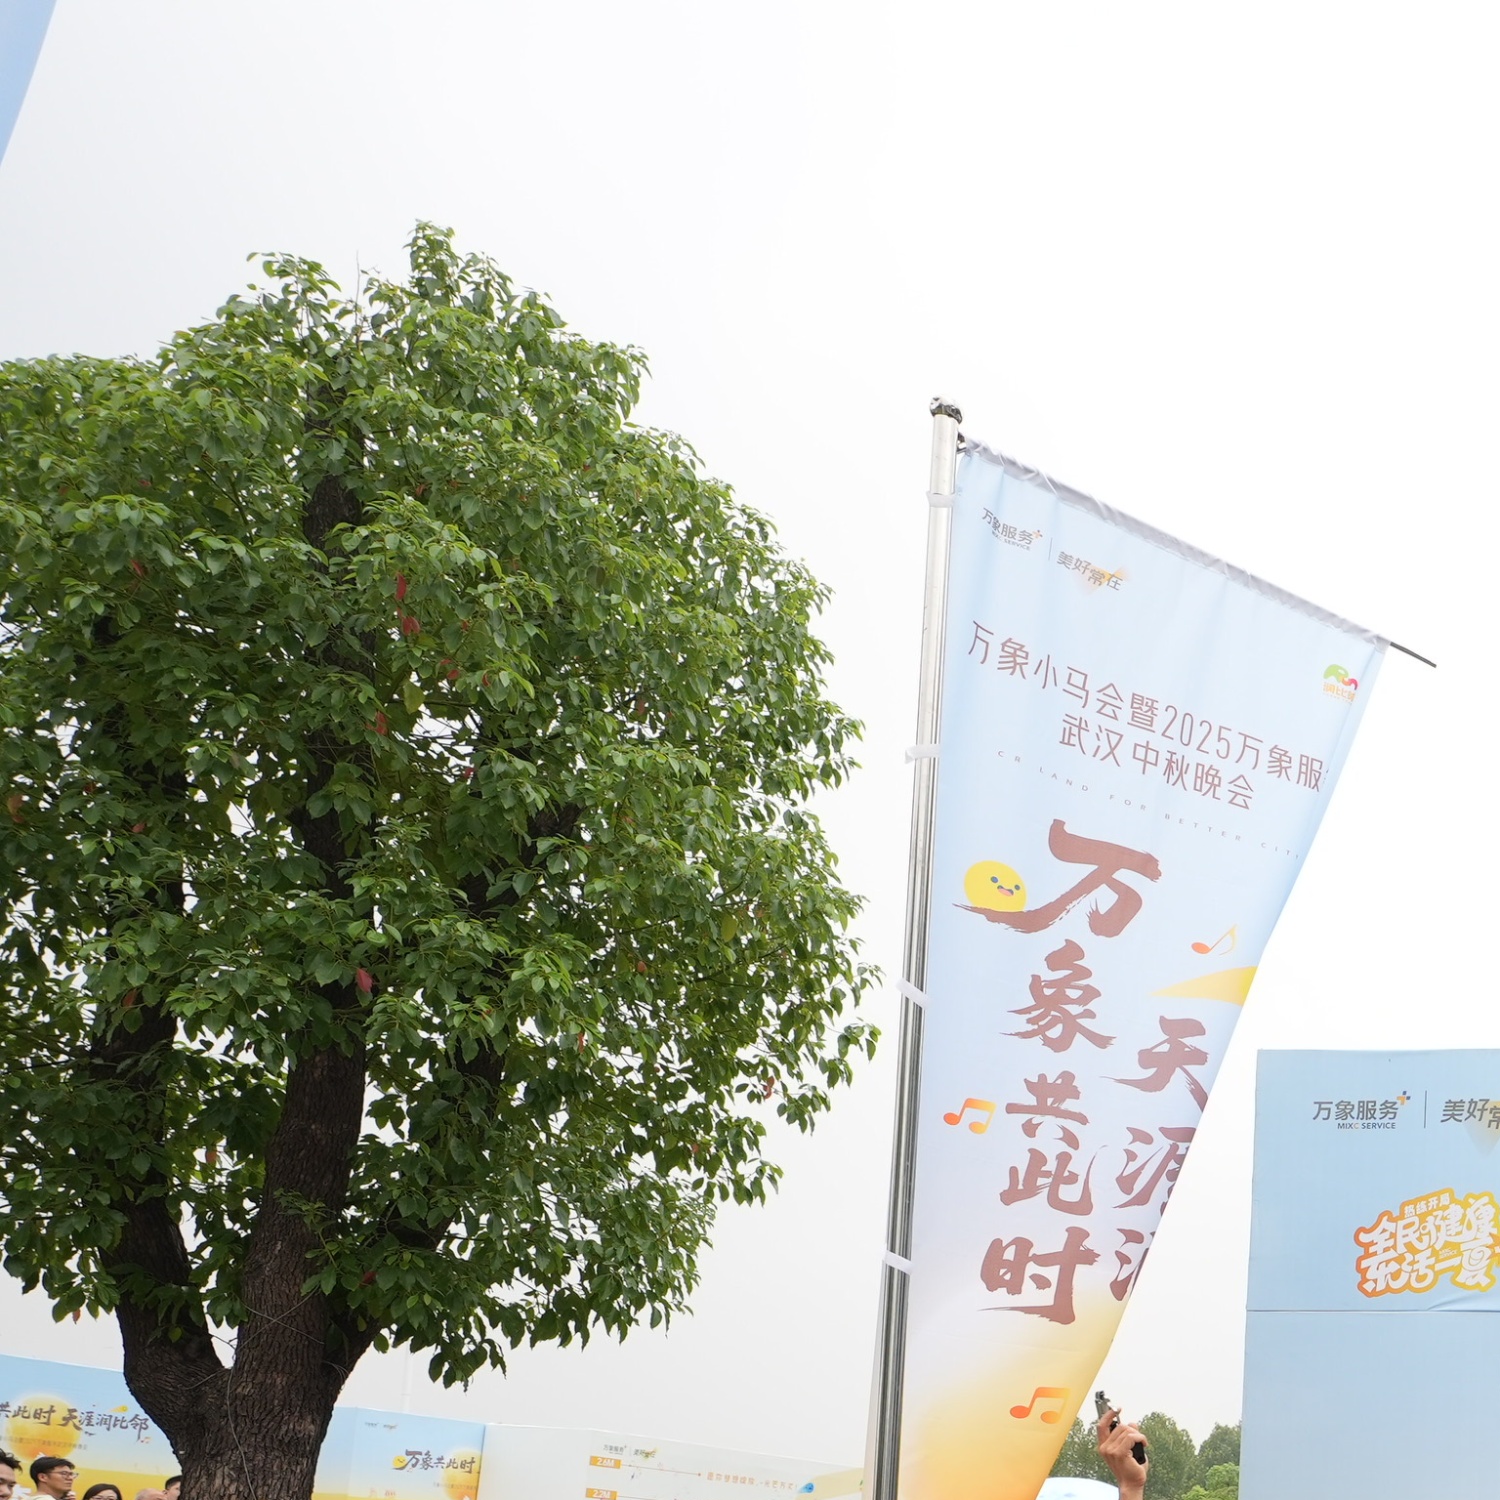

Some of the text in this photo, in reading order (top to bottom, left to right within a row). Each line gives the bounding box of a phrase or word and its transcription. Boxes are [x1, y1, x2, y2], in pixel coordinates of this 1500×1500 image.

[982, 507, 1034, 545] 万象服务
[1057, 551, 1123, 590] 美好常在
[968, 620, 1326, 793] 万象小马会暨2025万象服
[1059, 713, 1253, 811] 武汉中秋晚会
[998, 750, 1021, 763] CR
[1039, 766, 1088, 791] LAND
[1109, 794, 1146, 812] FOR
[1164, 813, 1241, 842] BETTER
[953, 819, 1163, 1325] 万象共此时
[1312, 1100, 1398, 1121] 万象服务
[392, 1449, 476, 1474] 万象共此时
[592, 1489, 611, 1499] 2.2M
